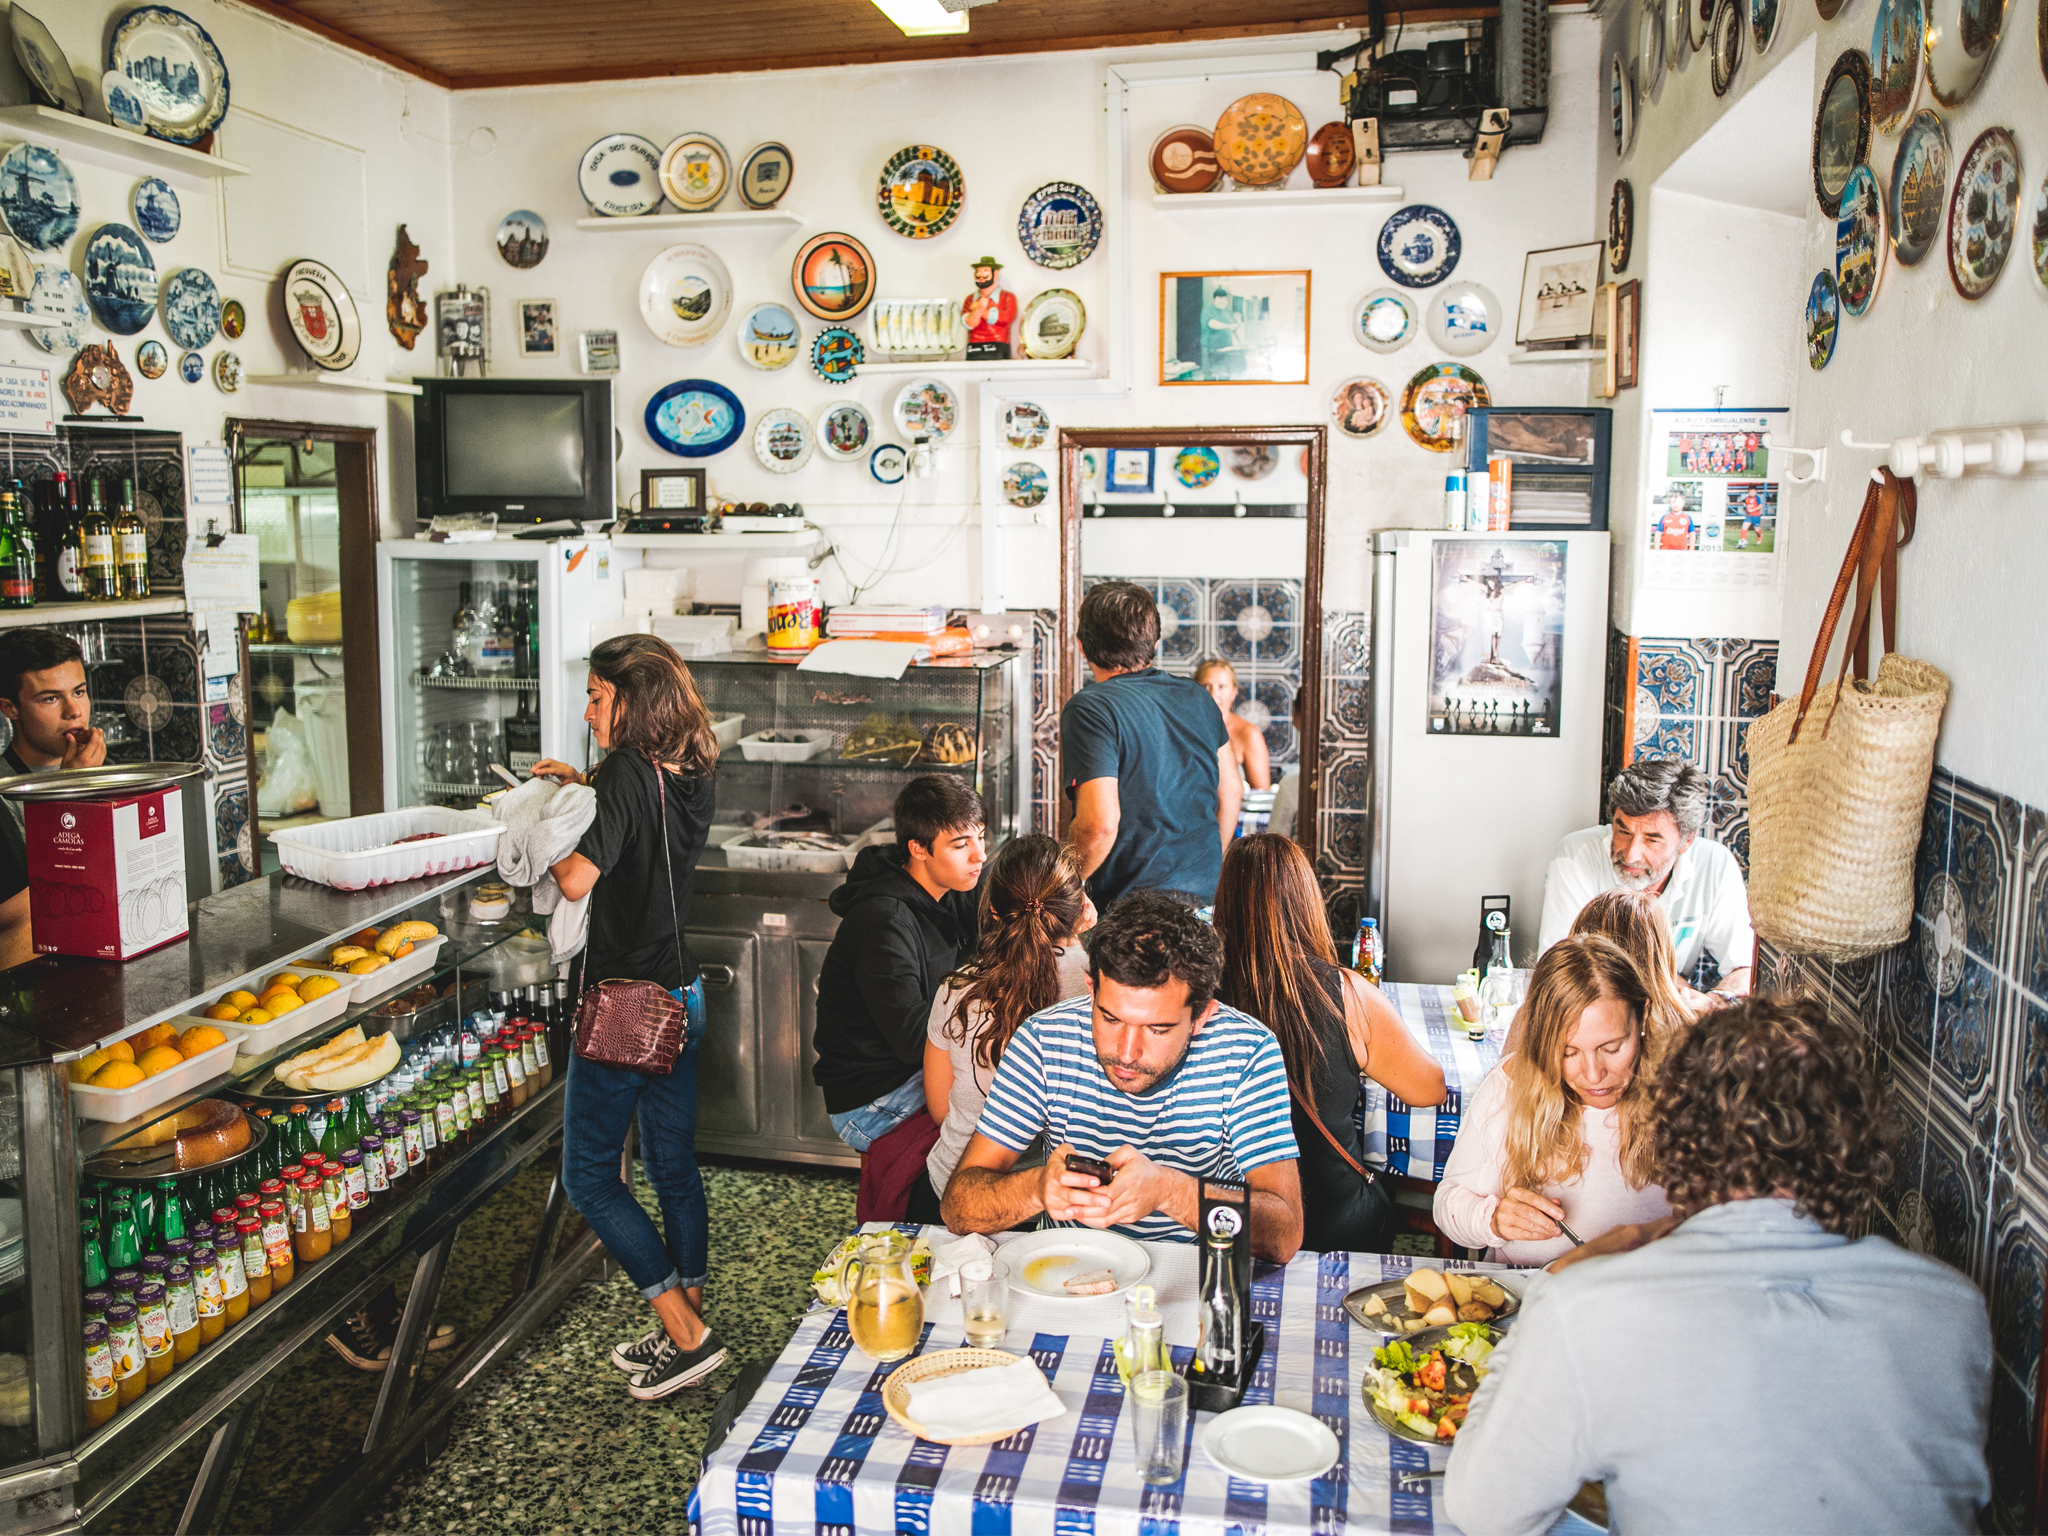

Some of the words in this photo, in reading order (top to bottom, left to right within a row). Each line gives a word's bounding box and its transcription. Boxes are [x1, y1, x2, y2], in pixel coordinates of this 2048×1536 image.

[1036, 183, 1077, 201] EPHESUS
[5, 377, 18, 385] CASA
[30, 379, 36, 388] SE
[0, 388, 16, 397] AIORES
[18, 389, 24, 397] DE
[34, 391, 47, 399] ANOS
[1521, 547, 1550, 559] Jesus
[1700, 544, 1722, 552] 2013
[57, 831, 81, 839] ADEGA
[53, 837, 84, 845] CAMOLAS
[269, 1242, 286, 1253] Nectar
